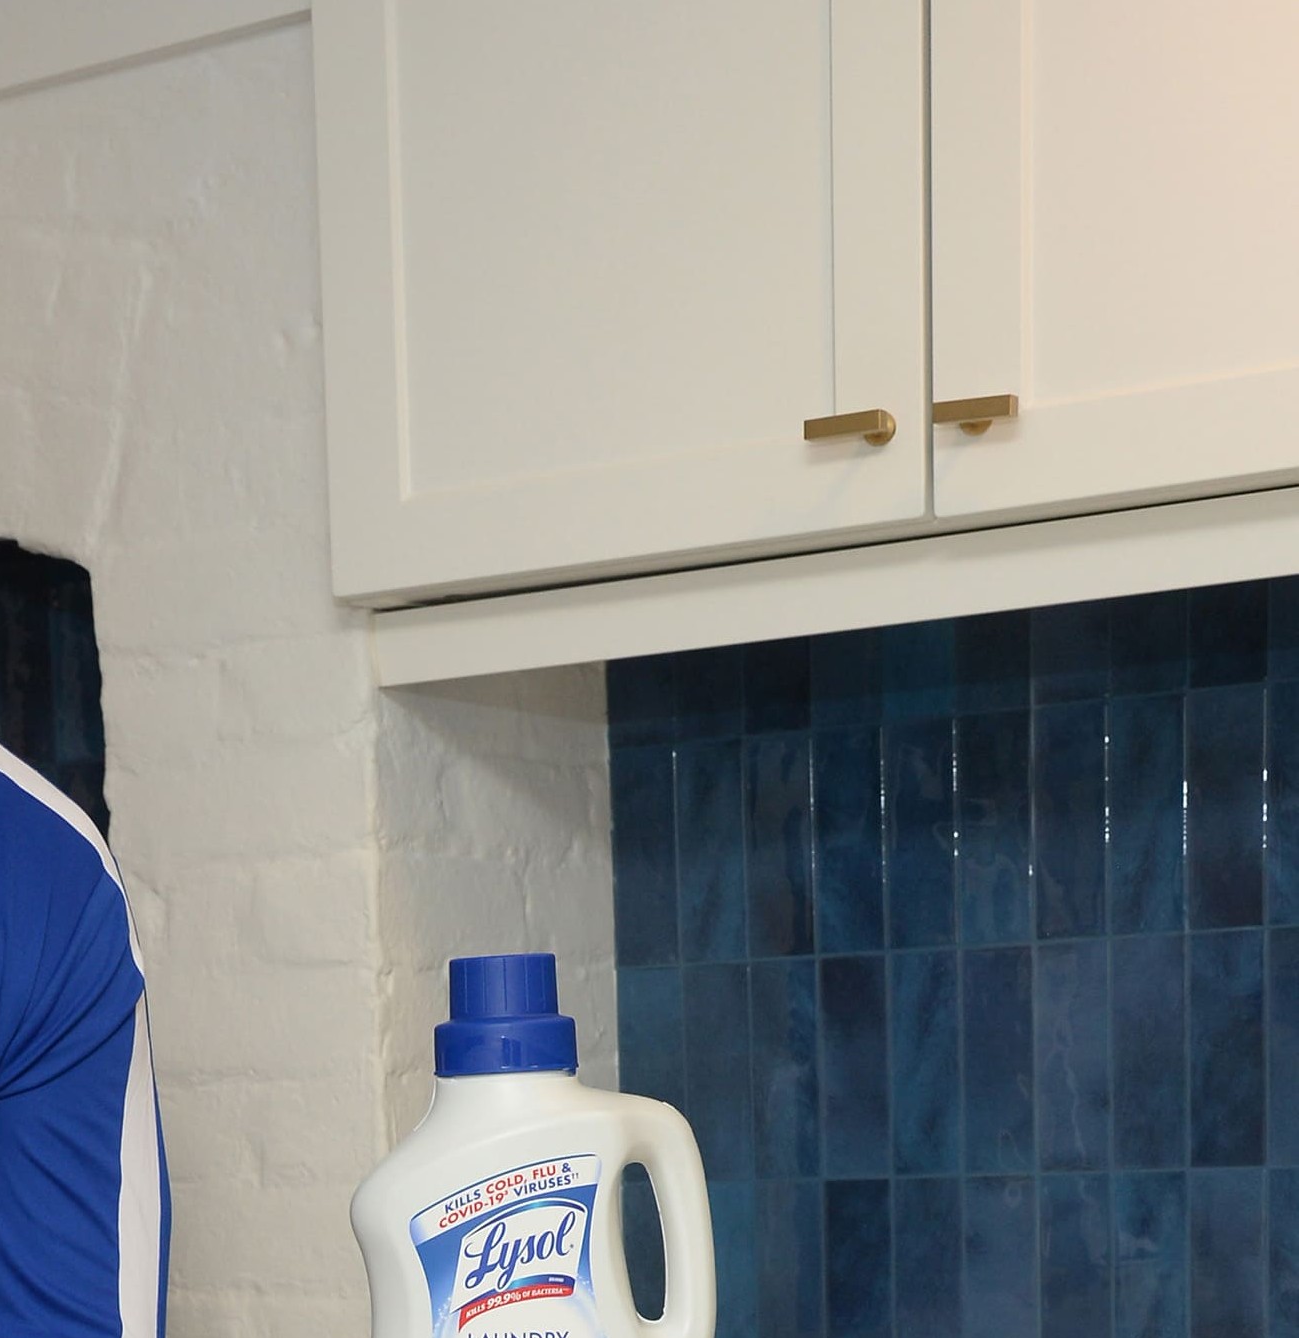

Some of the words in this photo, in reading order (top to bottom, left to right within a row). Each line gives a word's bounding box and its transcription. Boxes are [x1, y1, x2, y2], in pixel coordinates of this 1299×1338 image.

[444, 1189, 481, 1214] KILLS
[486, 1174, 527, 1195] COLD,
[532, 1165, 557, 1180] FLU
[561, 1163, 572, 1173] &
[464, 1211, 576, 1289] Lysol
[465, 1303, 486, 1319] KILLS
[486, 1291, 522, 1309] 99.9%
[522, 1289, 531, 1298] OF
